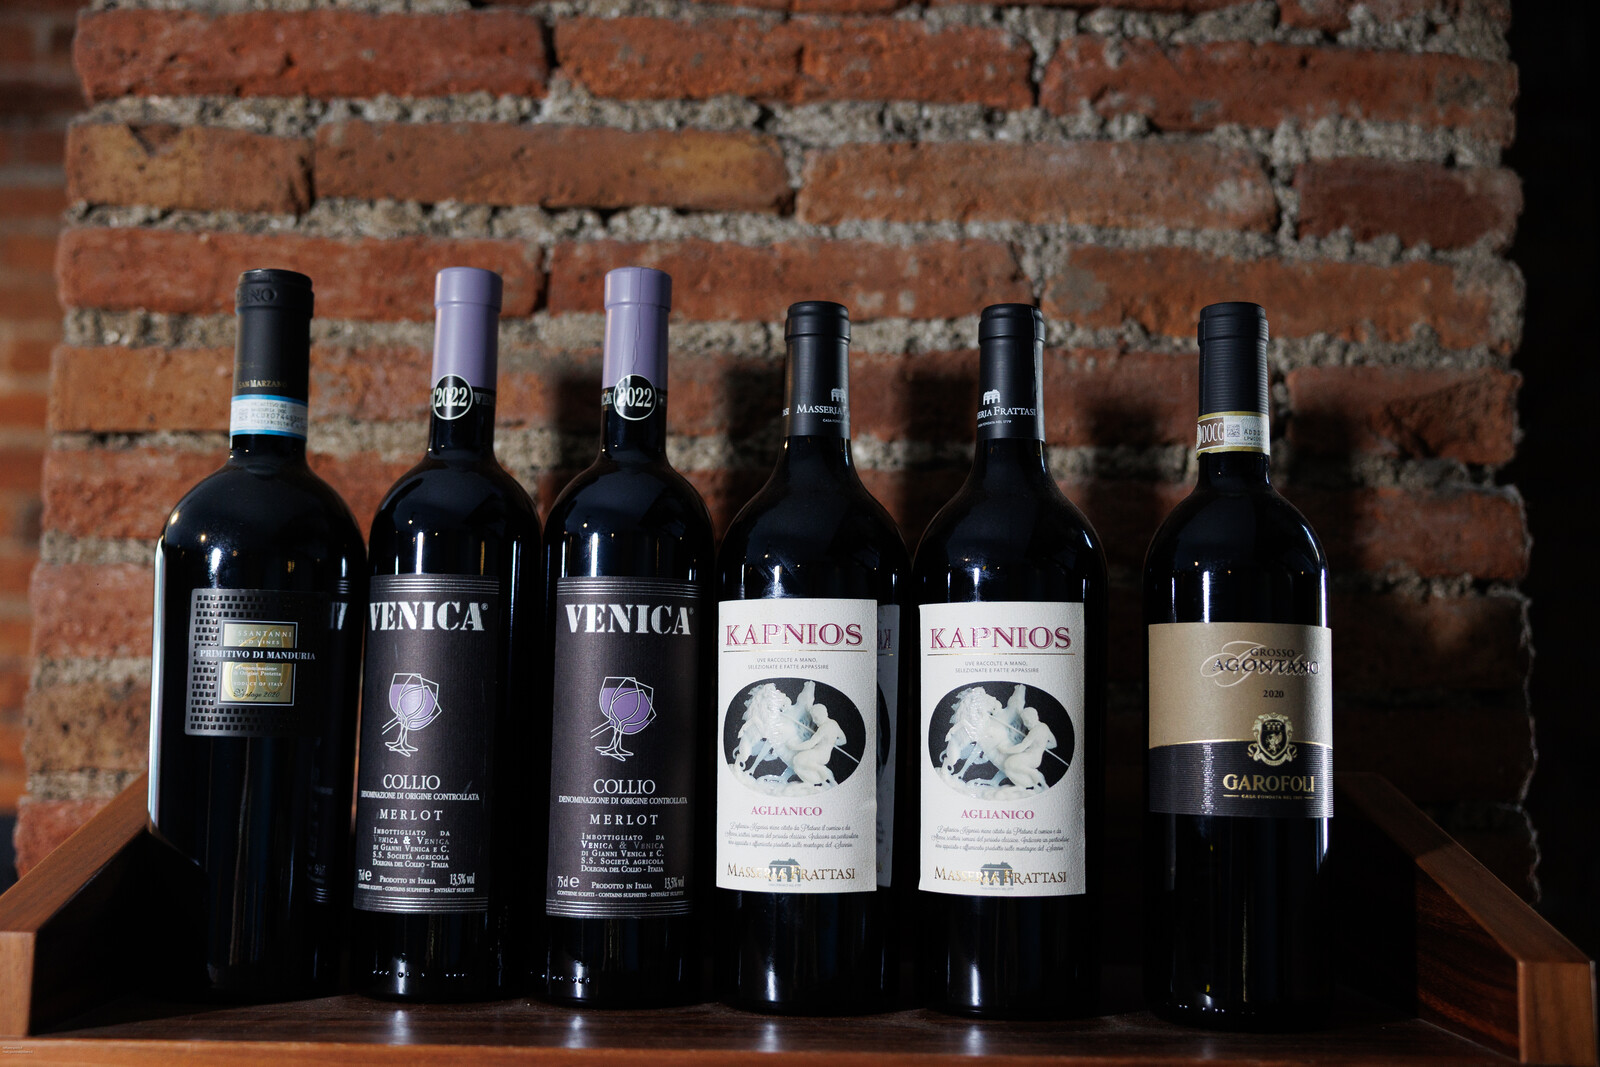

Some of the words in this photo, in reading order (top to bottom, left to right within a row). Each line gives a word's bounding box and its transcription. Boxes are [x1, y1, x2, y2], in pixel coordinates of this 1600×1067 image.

[435, 386, 468, 407] 2022
[616, 386, 653, 408] 2022
[796, 403, 842, 415] MASSERIA
[994, 406, 1037, 416] FRATTASI
[1202, 422, 1224, 444] DOCG
[726, 623, 863, 646] KAPNIOS
[930, 626, 1072, 649] KAPNIOS
[200, 649, 250, 659] PRIMITIVO
[252, 650, 265, 659] DI
[266, 650, 316, 660] MANDURIA
[1250, 647, 1295, 658] GROSSO
[1212, 658, 1319, 675] AGONTANO
[1263, 689, 1284, 698] 2020
[383, 774, 441, 790] COLLIO
[593, 779, 656, 794] COLLIO
[1222, 773, 1315, 793] GAROFOLI
[405, 792, 432, 800] ORIGINE
[433, 792, 480, 801] CONTROLLATA
[558, 795, 609, 804] DENOMINAZIONE
[620, 797, 648, 805] ORIGINE
[379, 808, 443, 820] MERLOT
[751, 805, 823, 817] AGLIANICO
[961, 809, 1035, 820] AGLIANICO
[589, 814, 658, 825] MERLOT
[417, 836, 450, 845] VENICA
[582, 832, 643, 841] IMBOTTIGLIATO
[381, 843, 401, 852] GIANNI
[405, 845, 430, 853] VENICA
[441, 845, 449, 853] C.
[581, 840, 613, 849] VENICA
[620, 841, 627, 849] &
[634, 841, 664, 849] VENICA
[591, 849, 617, 857] GIANNI
[621, 849, 646, 857] VENICA
[656, 849, 664, 857] C.
[405, 860, 425, 868] COLLIO
[621, 865, 642, 873] COLLIO
[790, 863, 856, 881] FRATTASI
[934, 866, 1000, 883] MASSERIA
[1003, 868, 1067, 885] FRATTASI
[379, 875, 407, 884] PRODOTTO
